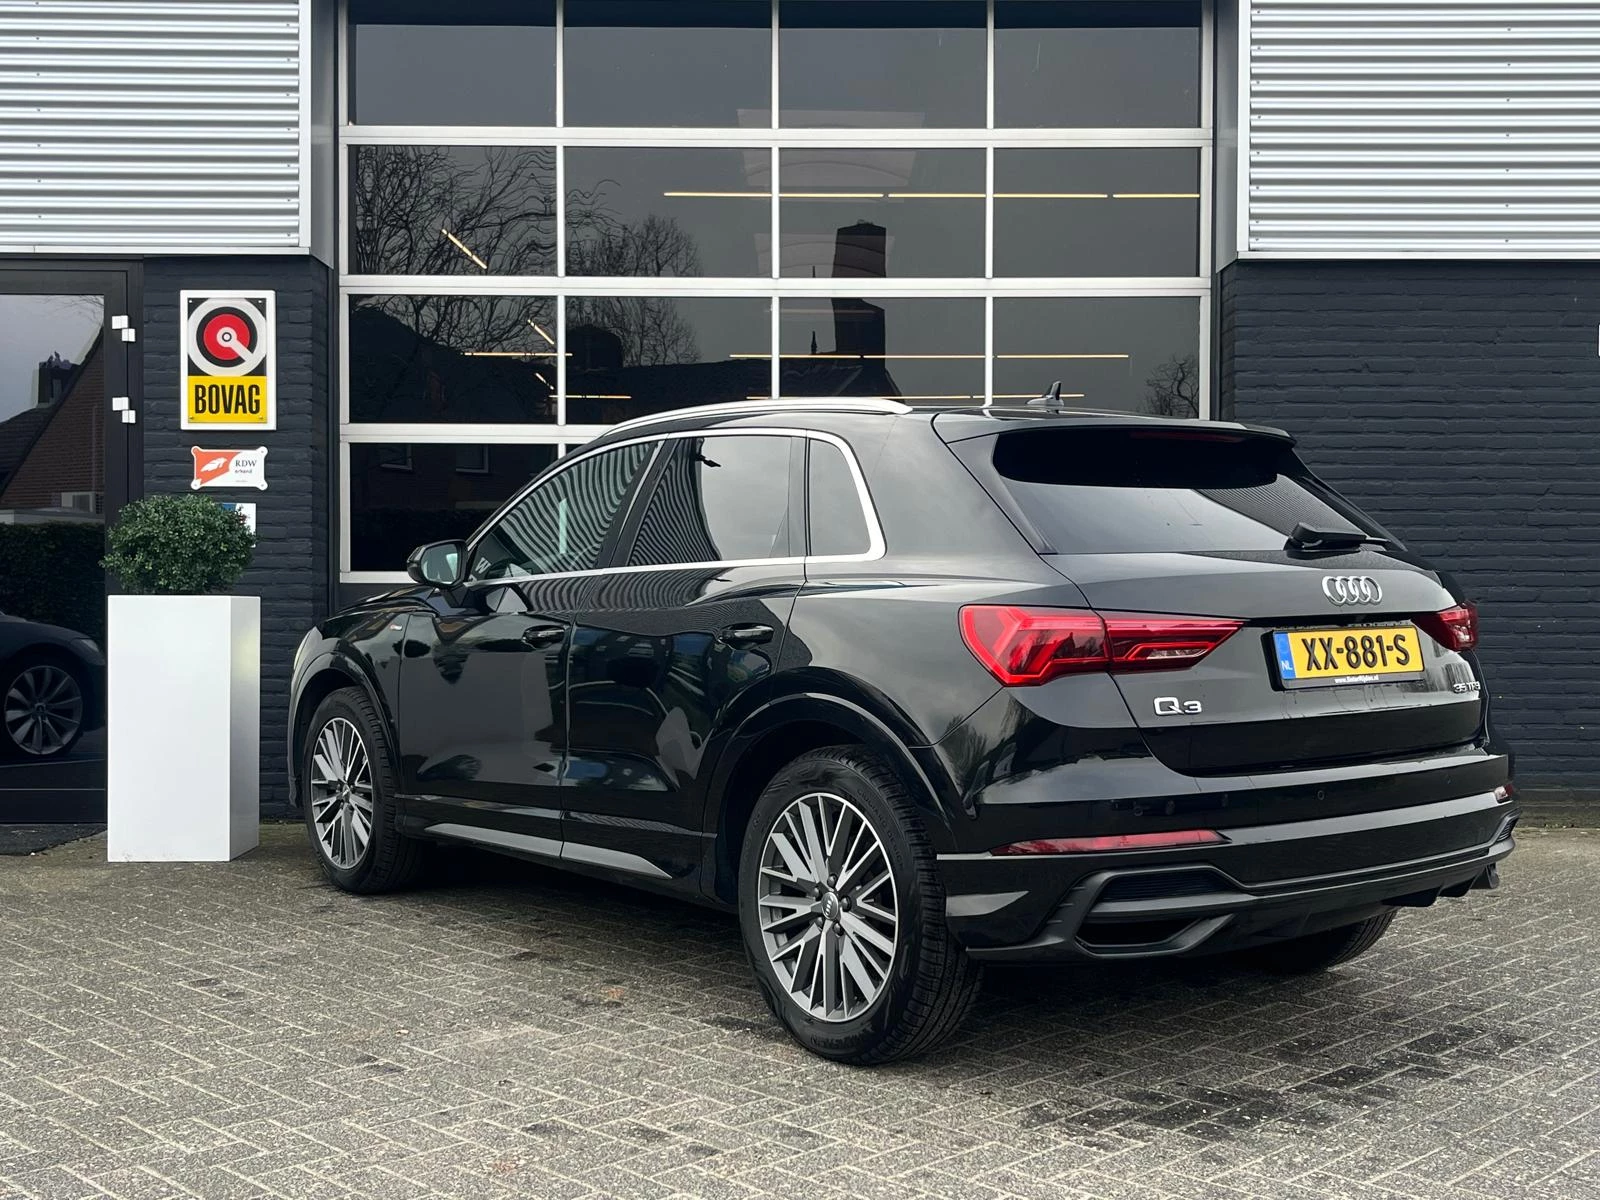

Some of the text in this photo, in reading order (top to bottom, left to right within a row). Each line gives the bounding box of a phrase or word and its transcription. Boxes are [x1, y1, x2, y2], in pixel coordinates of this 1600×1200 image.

[194, 384, 260, 414] BOVAG
[235, 459, 257, 467] RDW
[1301, 634, 1410, 671] XX-881-S
[1281, 660, 1293, 671] NL
[1453, 682, 1467, 693] 35
[1154, 697, 1202, 715] Q3
